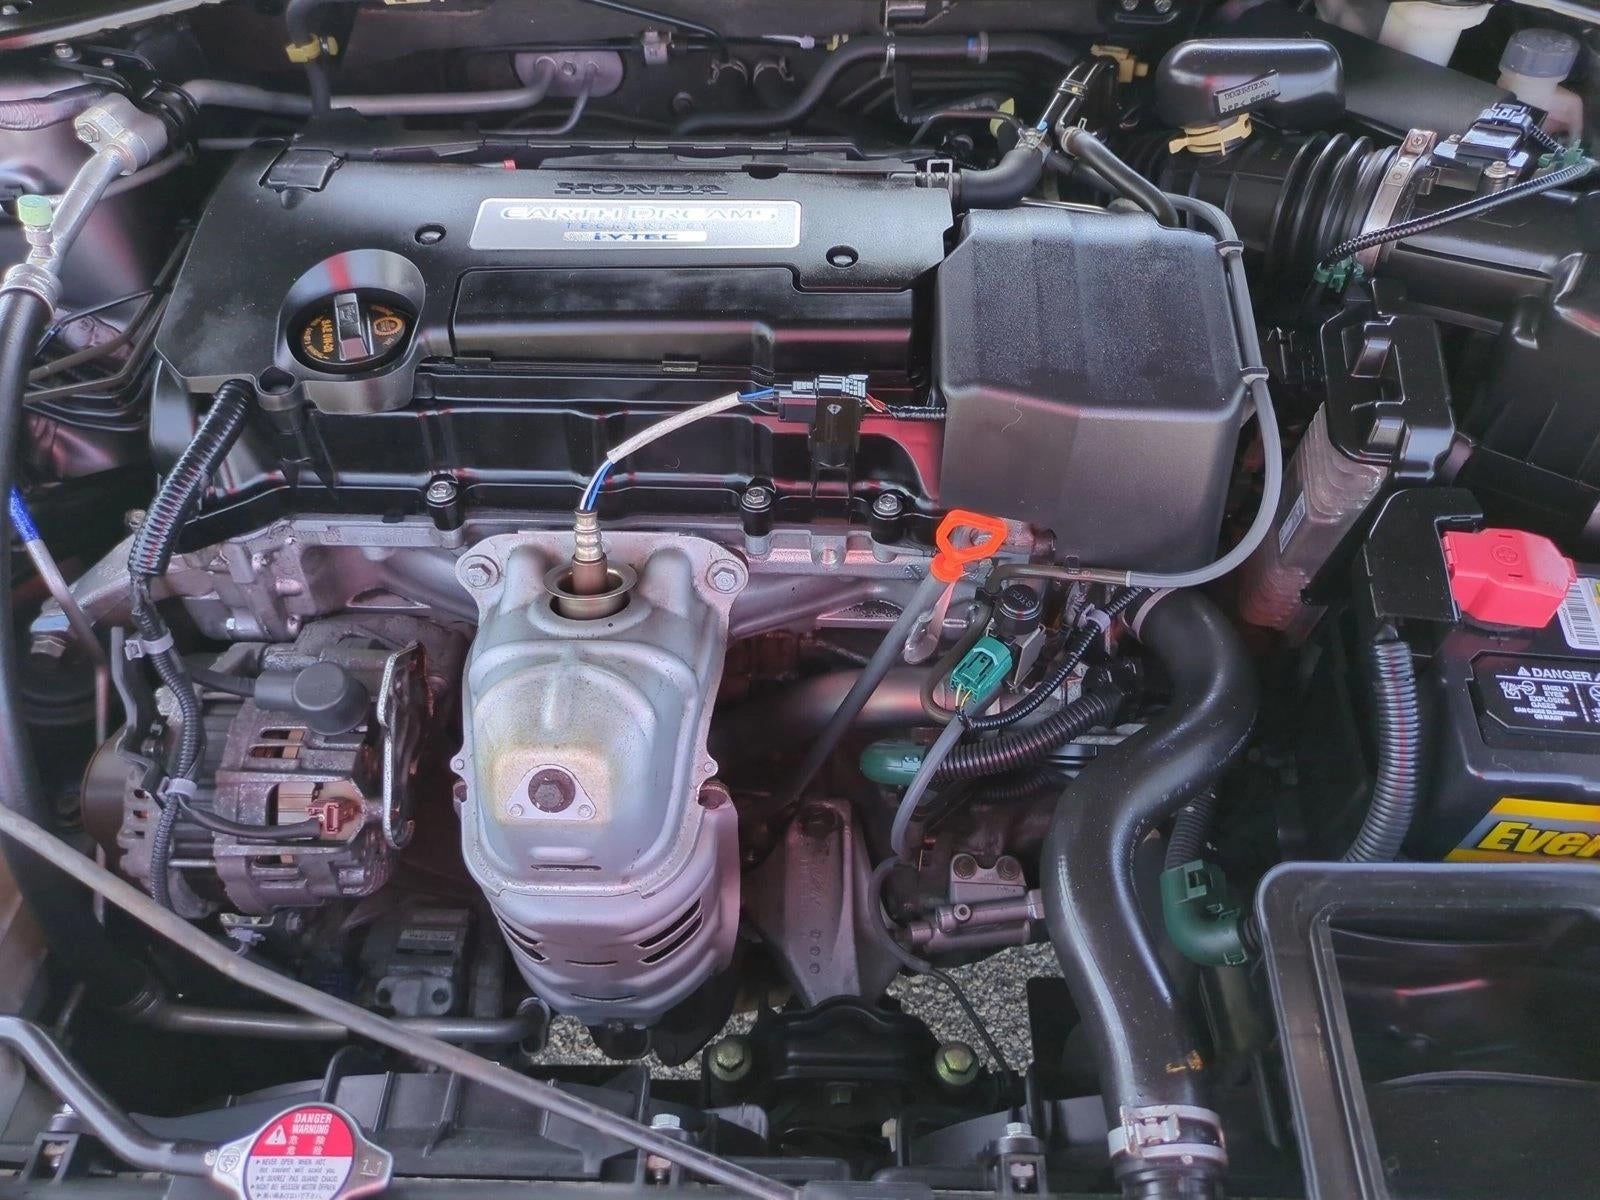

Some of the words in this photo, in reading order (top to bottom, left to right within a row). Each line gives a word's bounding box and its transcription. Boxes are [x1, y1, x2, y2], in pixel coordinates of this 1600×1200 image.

[554, 182, 728, 195] HONDA
[1531, 667, 1593, 681] DANGER
[1529, 696, 1571, 704] EXPLOSIVE
[294, 1113, 332, 1124] DANGER
[291, 1124, 330, 1135] WARNUNG
